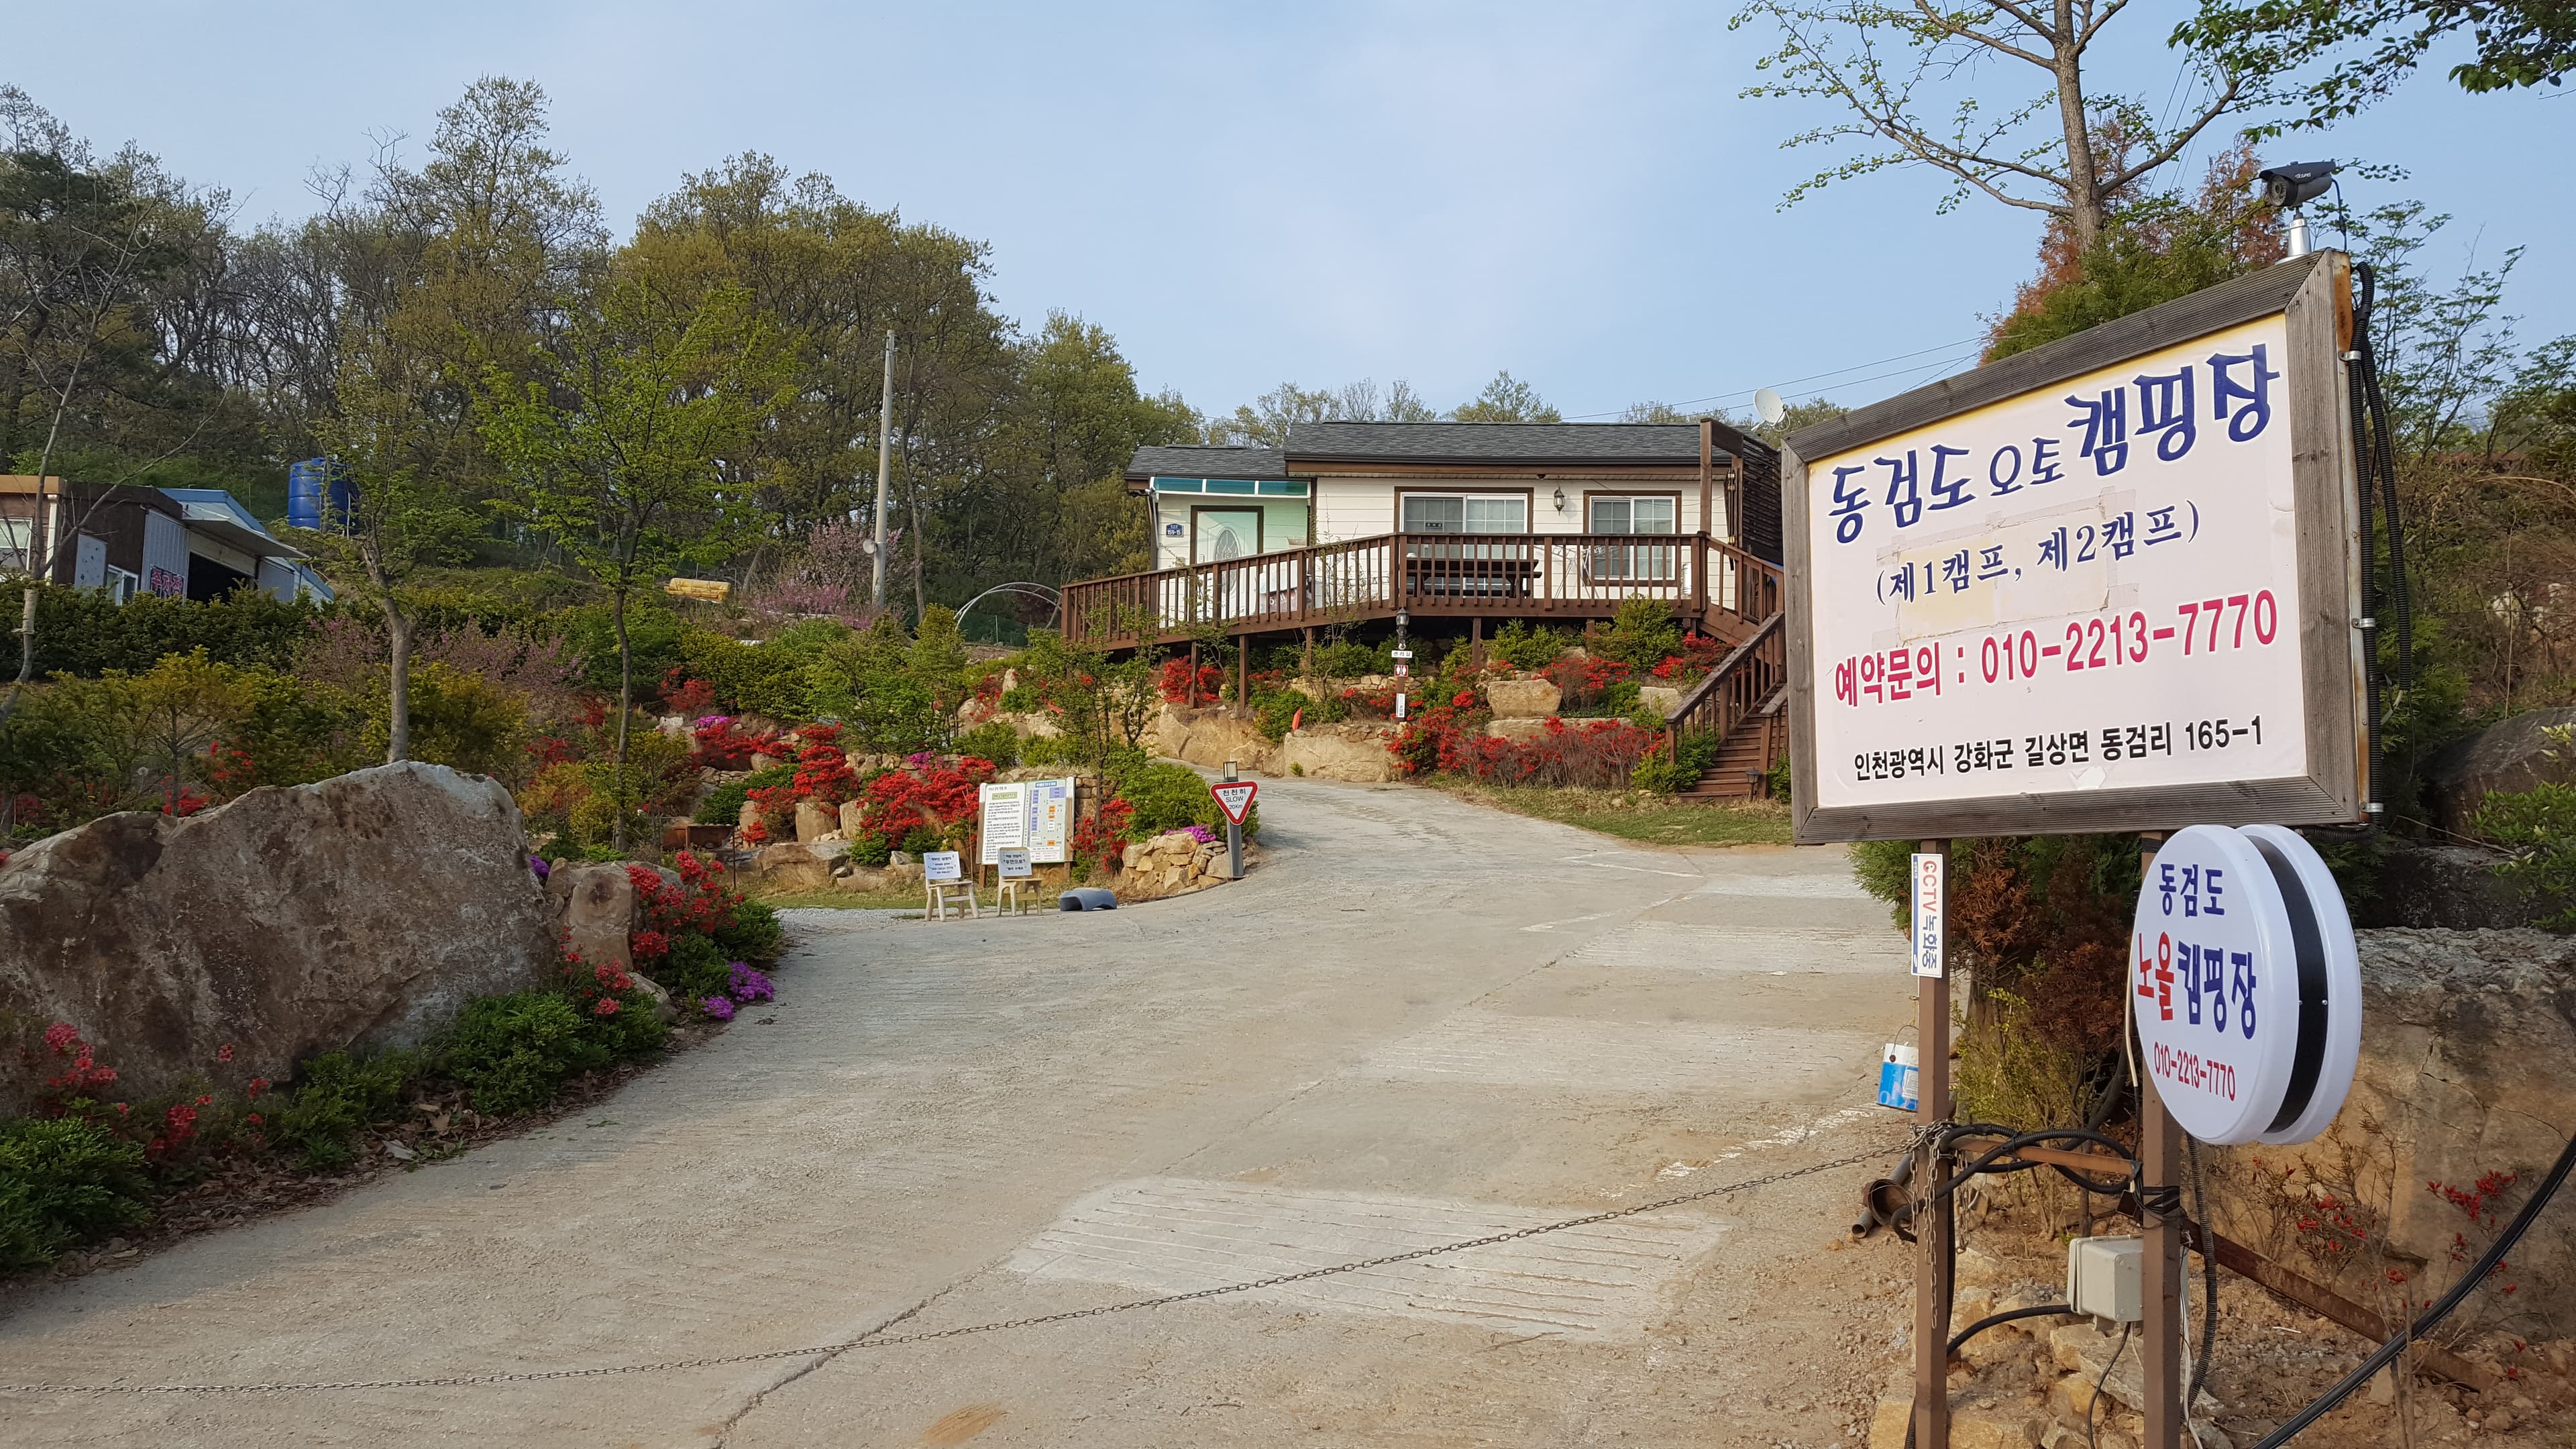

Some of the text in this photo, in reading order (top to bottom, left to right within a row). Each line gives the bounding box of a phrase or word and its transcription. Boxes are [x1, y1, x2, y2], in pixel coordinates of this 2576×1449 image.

[1835, 647, 1943, 706] 예약문의
[1981, 590, 2278, 684] 010-2213-7770
[1854, 716, 2263, 782] 인천광역시 강화군 길상면 동검리 165-1
[1224, 788, 1246, 796] 천천히
[1922, 860, 1937, 969] CCTV 녹화중
[2159, 864, 2225, 918] 동검도
[2154, 1042, 2236, 1102] 010-2213-7770
